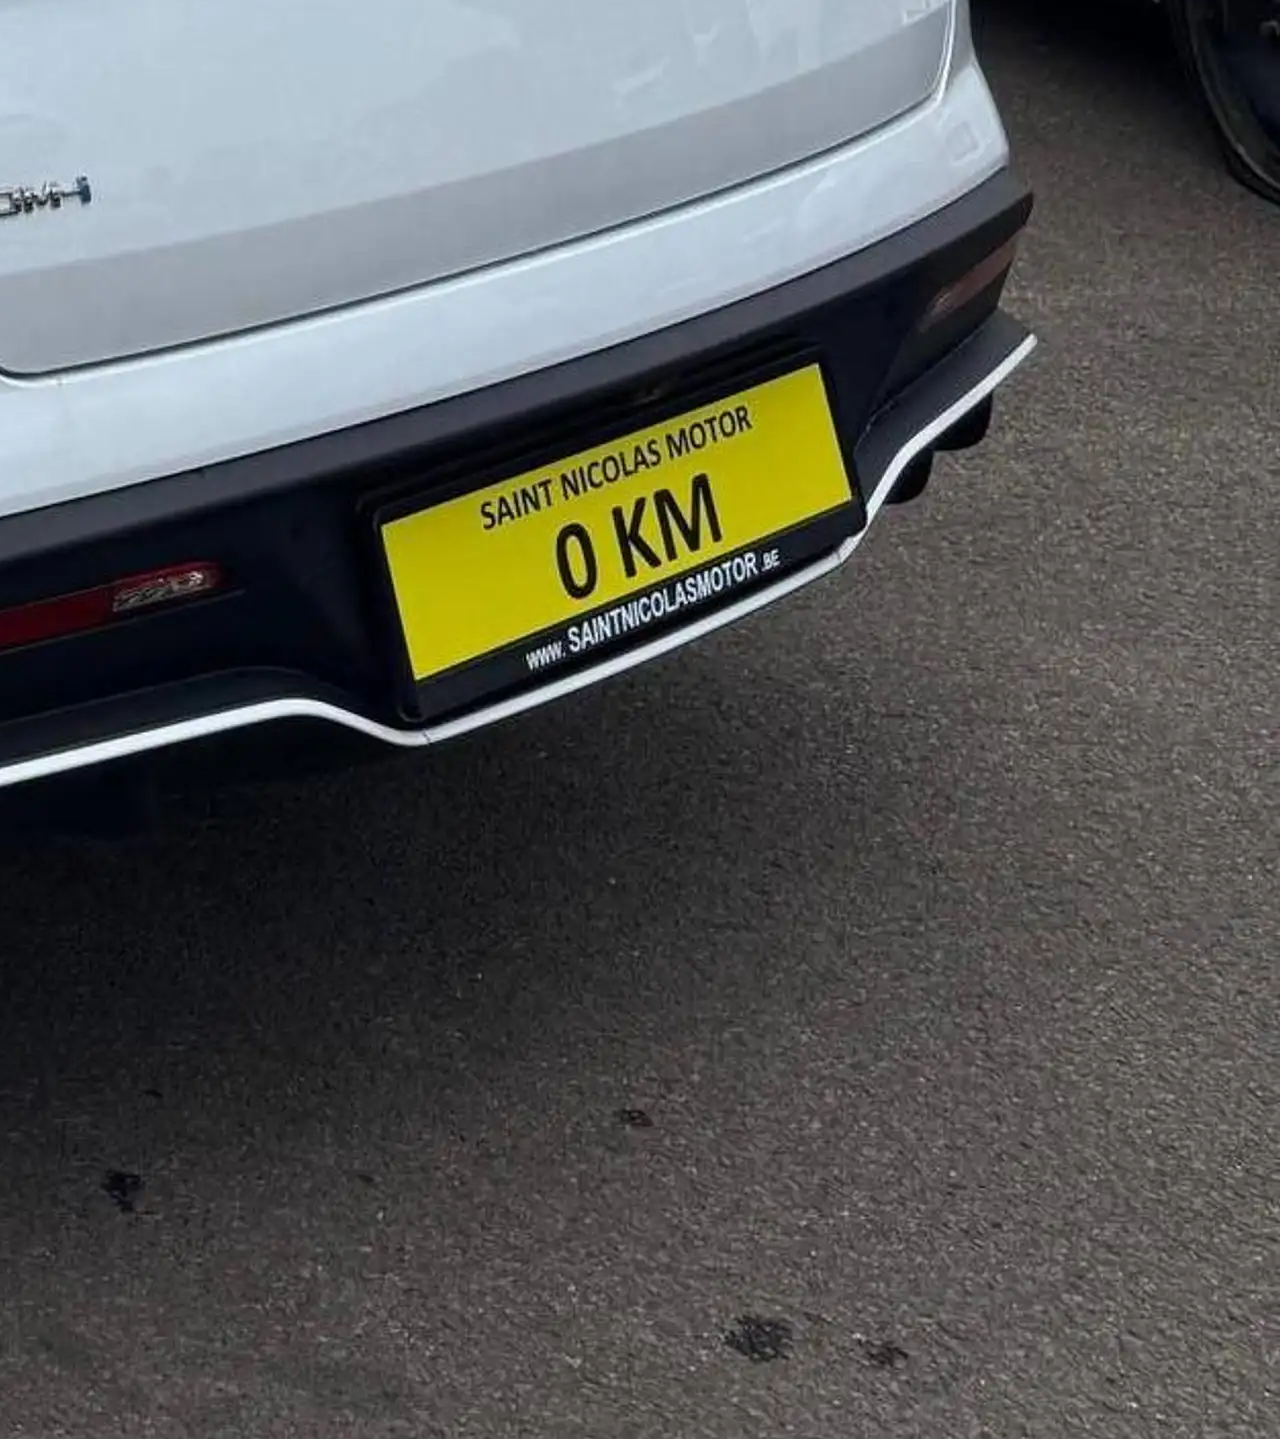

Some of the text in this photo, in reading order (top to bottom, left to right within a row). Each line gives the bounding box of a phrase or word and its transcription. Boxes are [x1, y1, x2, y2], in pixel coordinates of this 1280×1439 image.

[480, 405, 753, 530] SAINT NICOLAS MOTOR
[555, 471, 723, 600] 0 KM
[567, 551, 760, 653] SAINTNICOLASMOTOR
